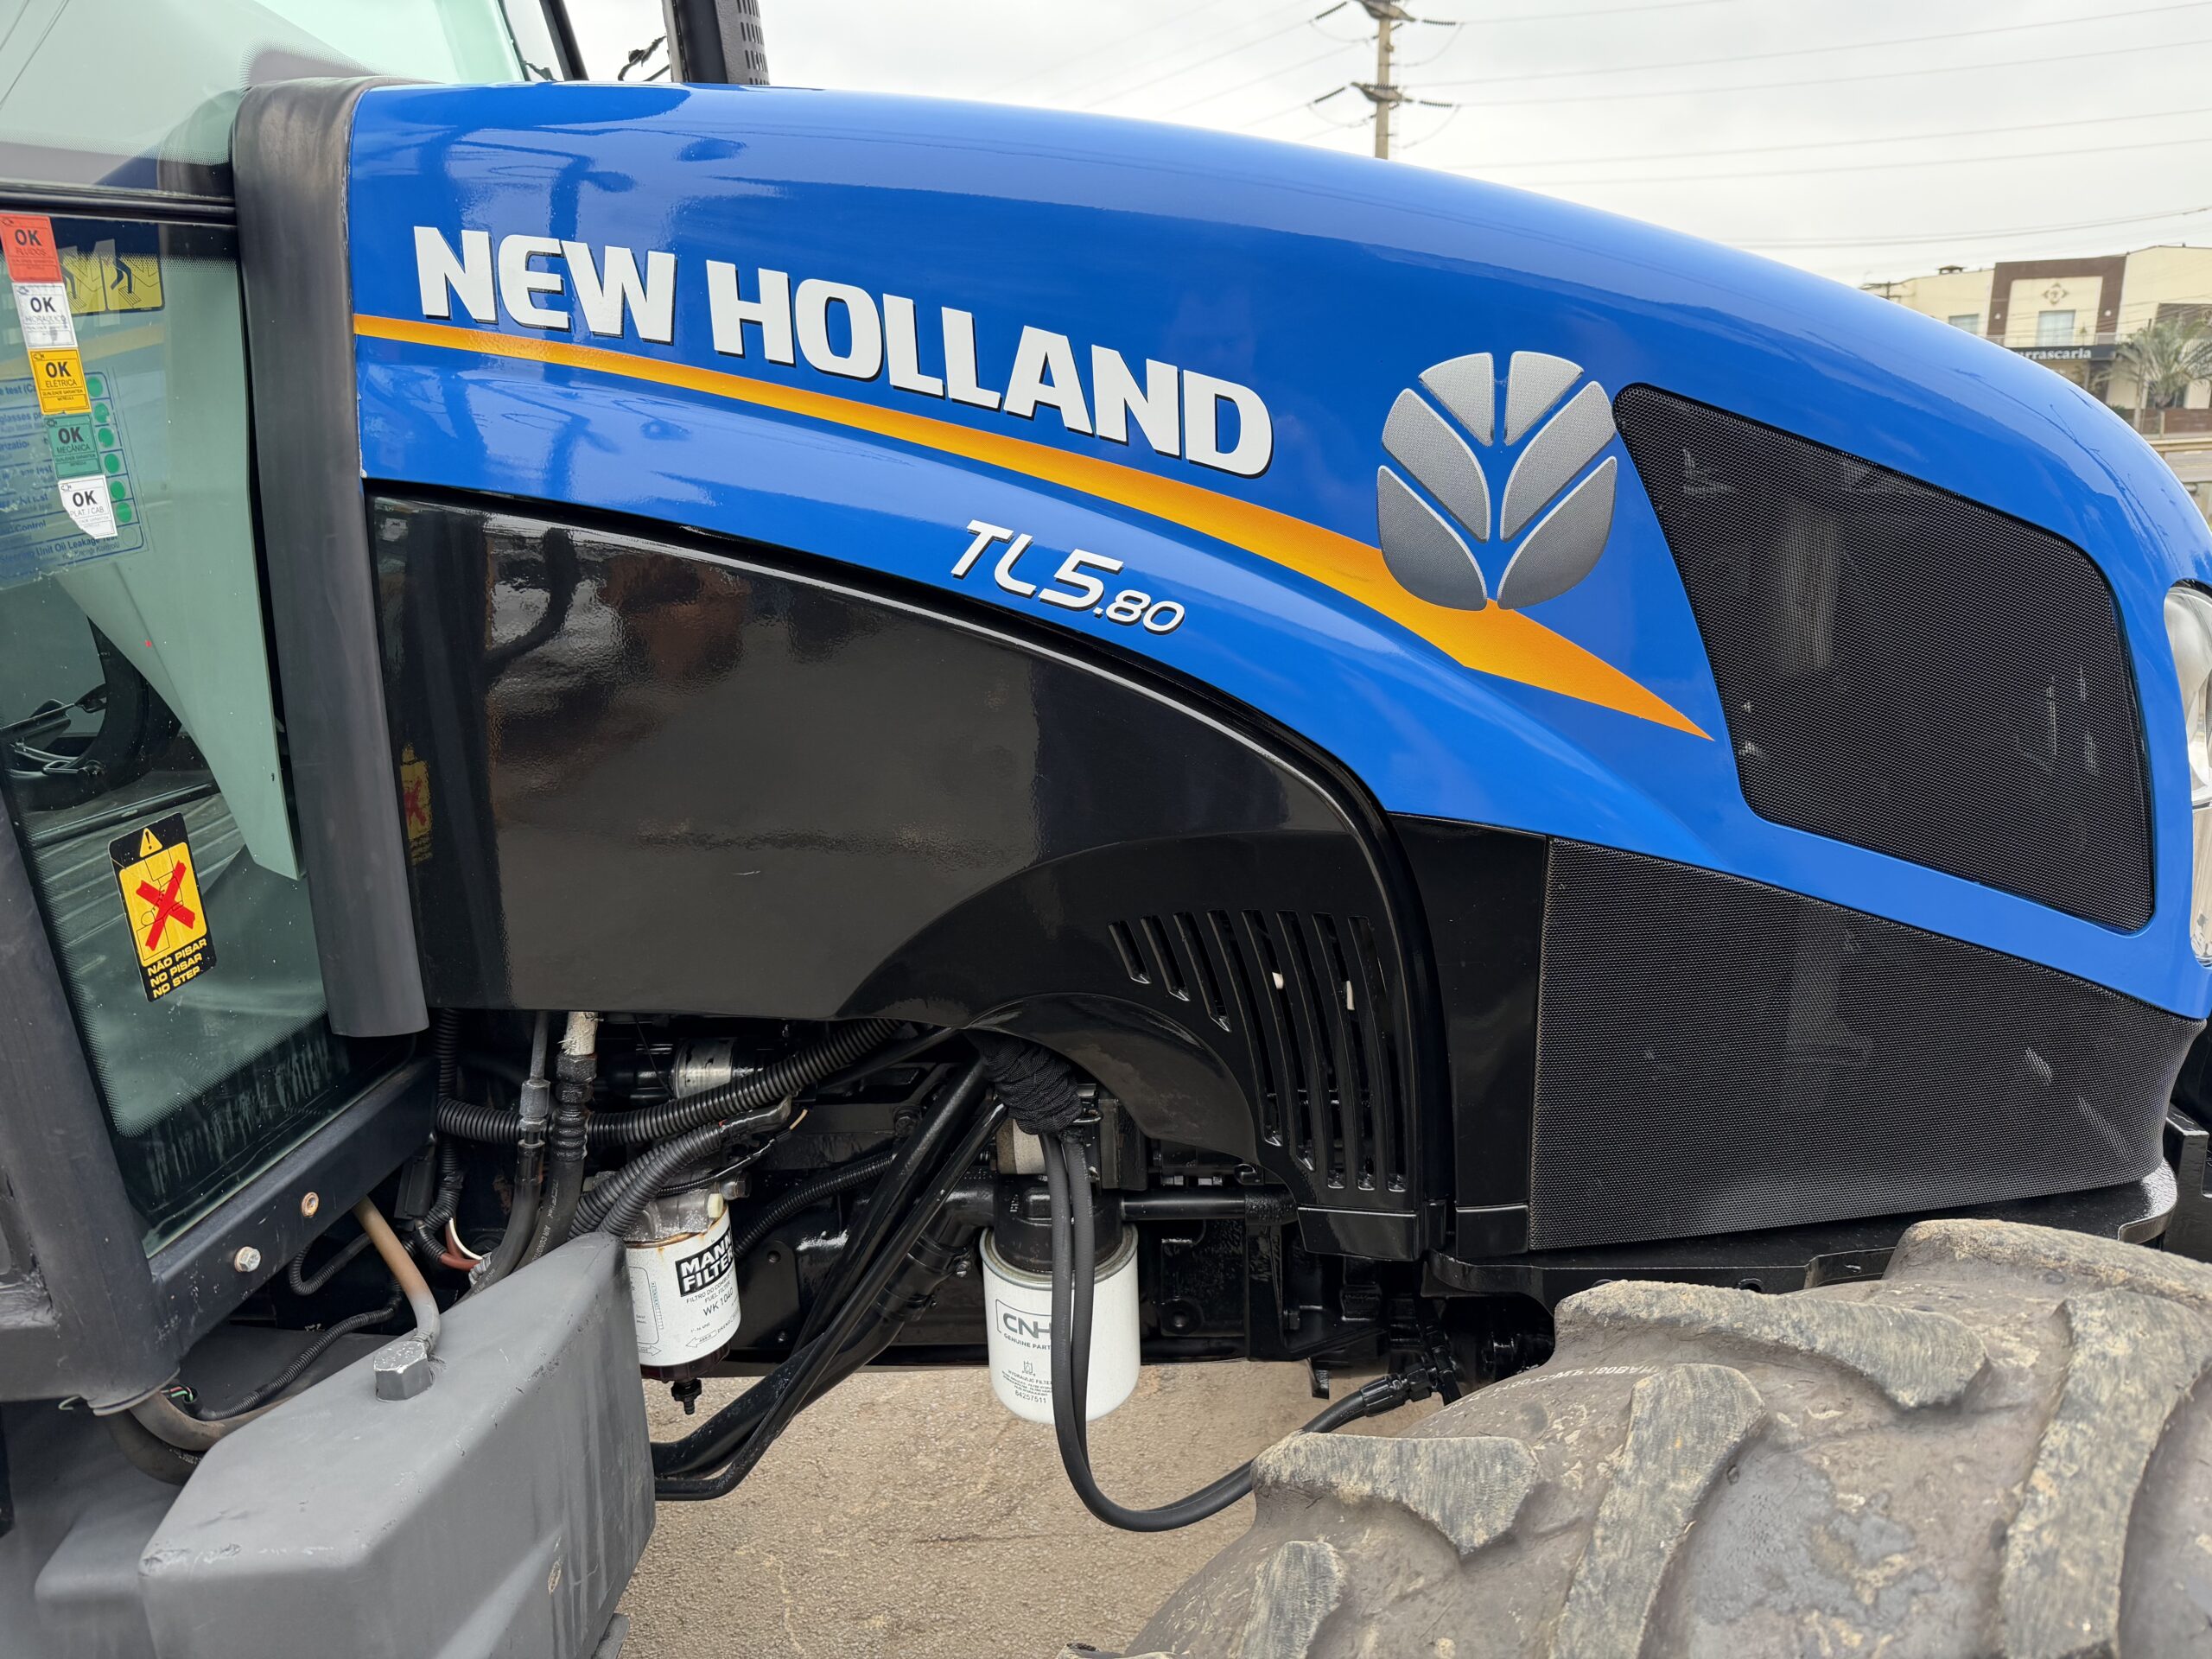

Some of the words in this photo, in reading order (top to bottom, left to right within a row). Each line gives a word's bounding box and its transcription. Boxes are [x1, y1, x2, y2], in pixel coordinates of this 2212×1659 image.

[15, 229, 42, 246] OK
[30, 296, 57, 313] OK
[414, 226, 678, 346] NEW
[706, 258, 1274, 478] HOLLAND
[46, 360, 72, 378] OK
[58, 427, 84, 445] OK
[73, 490, 98, 508] OK
[950, 519, 1185, 636] TL5.80
[147, 957, 173, 976] NÃO
[175, 938, 207, 962] PISAR
[150, 971, 168, 988] NO
[169, 952, 203, 976] PISAR
[152, 982, 171, 999] NO
[172, 965, 200, 987] STEP
[680, 1229, 733, 1278] MANN
[683, 1245, 734, 1293] FILTER
[686, 1291, 706, 1304] FILTRO
[704, 1294, 719, 1303] FUEL
[702, 1300, 719, 1316] WK
[1003, 1332, 1031, 1348] GENUINE
[1007, 1369, 1035, 1383] HYDRAULIC
